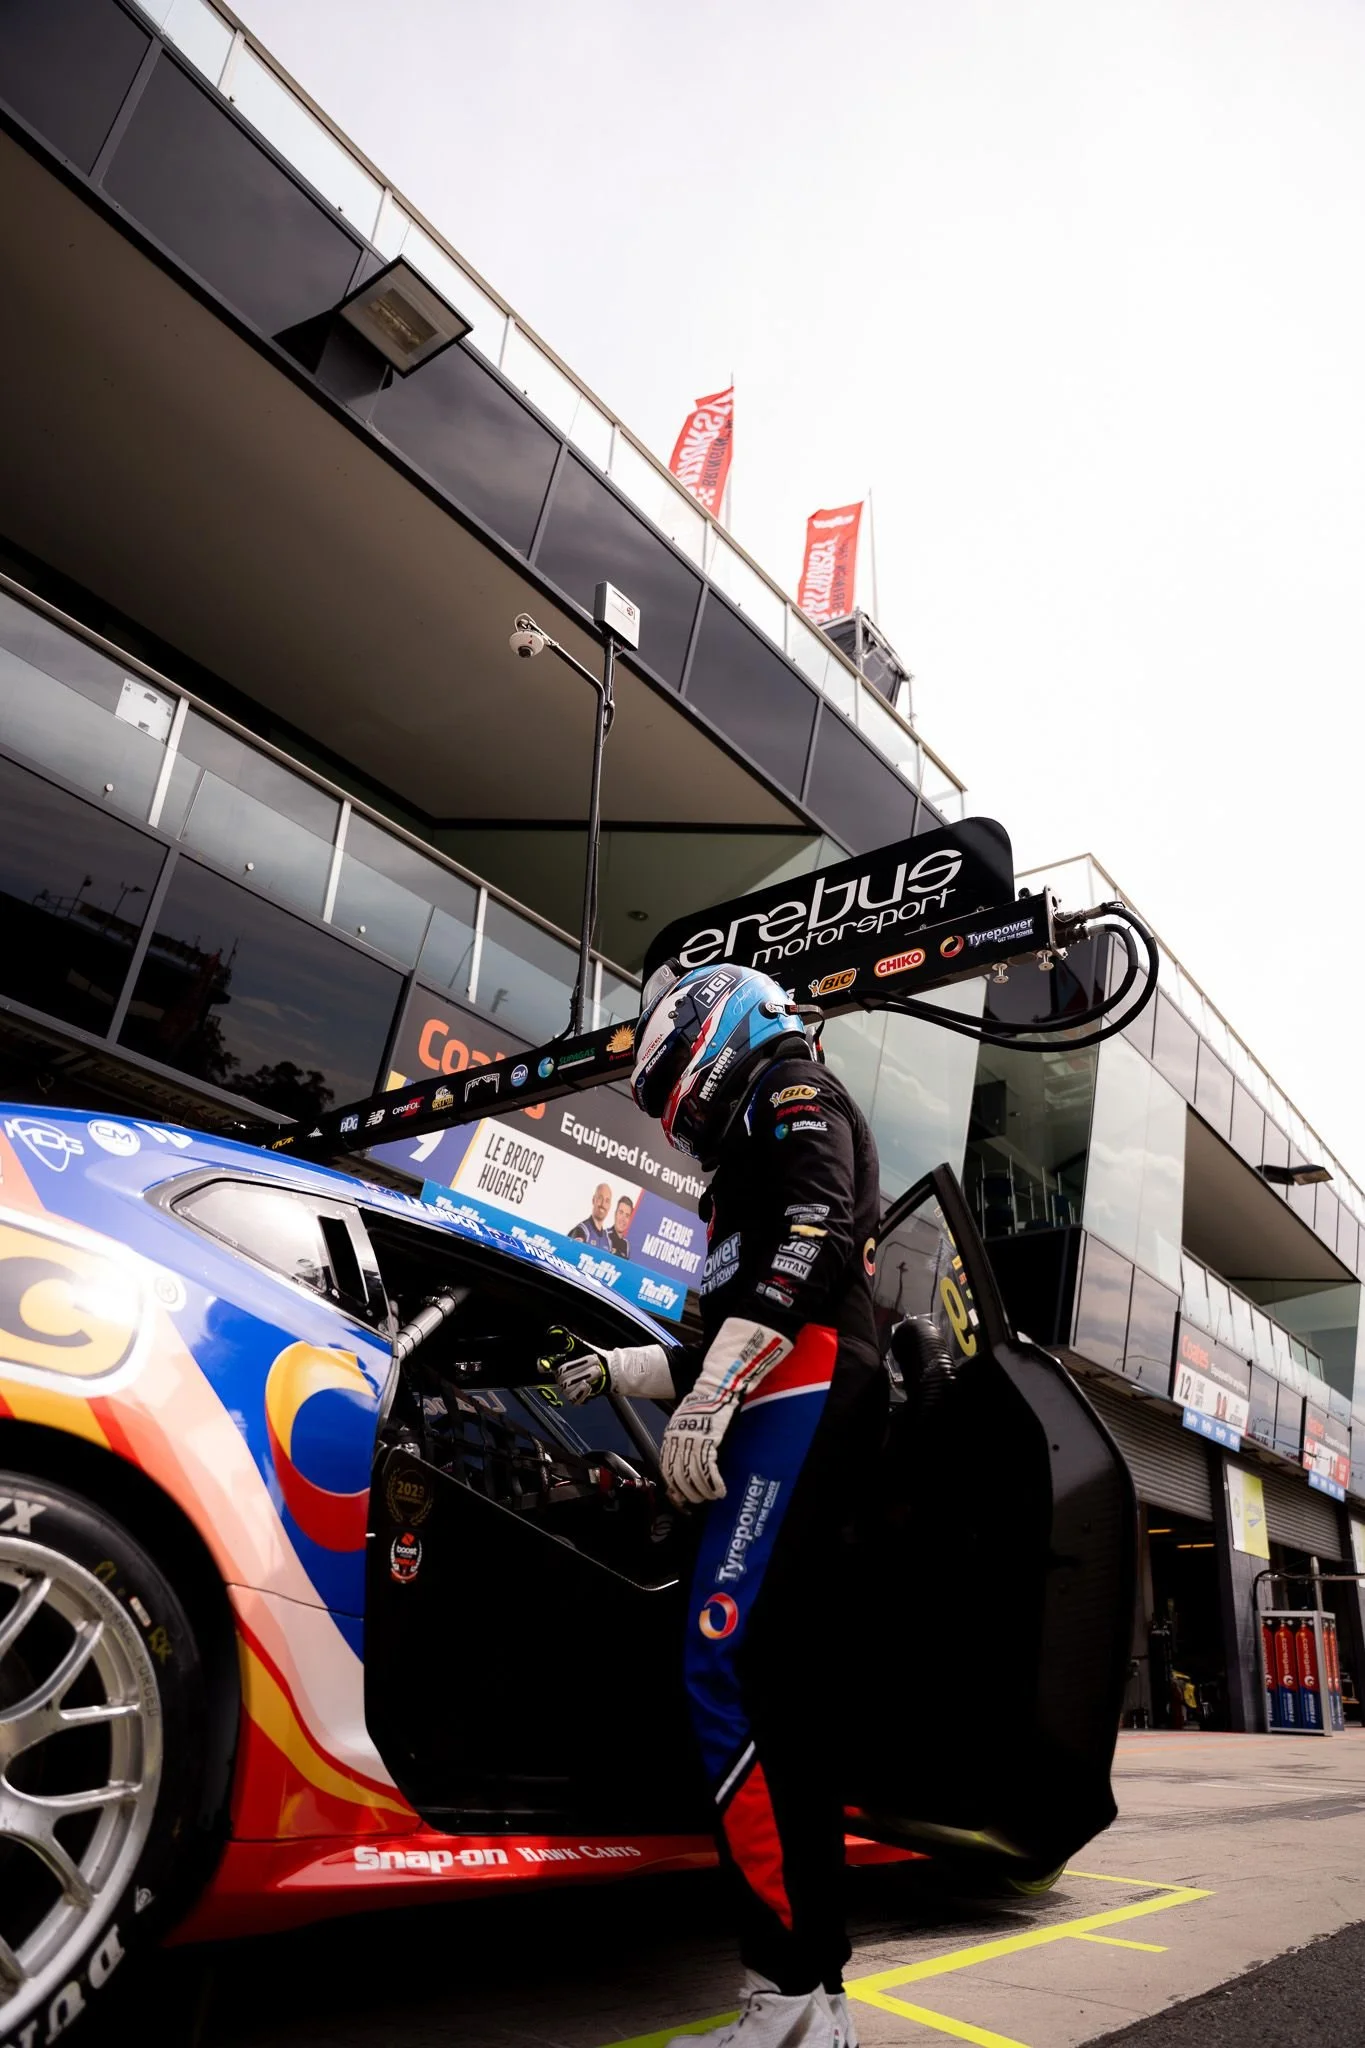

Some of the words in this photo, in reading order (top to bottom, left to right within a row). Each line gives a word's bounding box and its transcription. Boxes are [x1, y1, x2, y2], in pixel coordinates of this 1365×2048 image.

[679, 849, 963, 969] erebus
[751, 888, 957, 968] motorsport
[967, 918, 1033, 946] Tyrepower
[877, 952, 922, 973] CHIKO
[701, 972, 732, 1004] JGI
[559, 1047, 596, 1064] SUPAGAS
[513, 1070, 526, 1079] CM
[698, 1046, 734, 1101] METHOD
[392, 1101, 421, 1115] ORAFOL
[95, 1125, 132, 1145] CM
[792, 1119, 827, 1129] SUPAGAS
[485, 1133, 505, 1162] LE
[502, 1141, 545, 1183] BROCQ
[560, 1112, 639, 1167] Equipped
[639, 1151, 662, 1178] for
[661, 1165, 706, 1199] anythi
[477, 1163, 528, 1204] HUGHES
[404, 1195, 427, 1211] LE
[424, 1203, 484, 1236] BROCQ
[658, 1216, 694, 1247] EREBUS
[641, 1233, 702, 1274] MOTORSPORT
[782, 1241, 817, 1259] JGI
[577, 1252, 622, 1287] Thrifty
[777, 1257, 807, 1275] TITAN
[640, 1277, 679, 1310] Thrifty
[1179, 1372, 1191, 1400] 12
[397, 1480, 425, 1497] 2023
[763, 1480, 781, 1509] POWER
[718, 1474, 767, 1582] Tyrepower
[396, 1545, 418, 1556] boost
[353, 1846, 509, 1873] Snap-on
[515, 1846, 579, 1863] HAWK
[578, 1845, 641, 1859] CARTS
